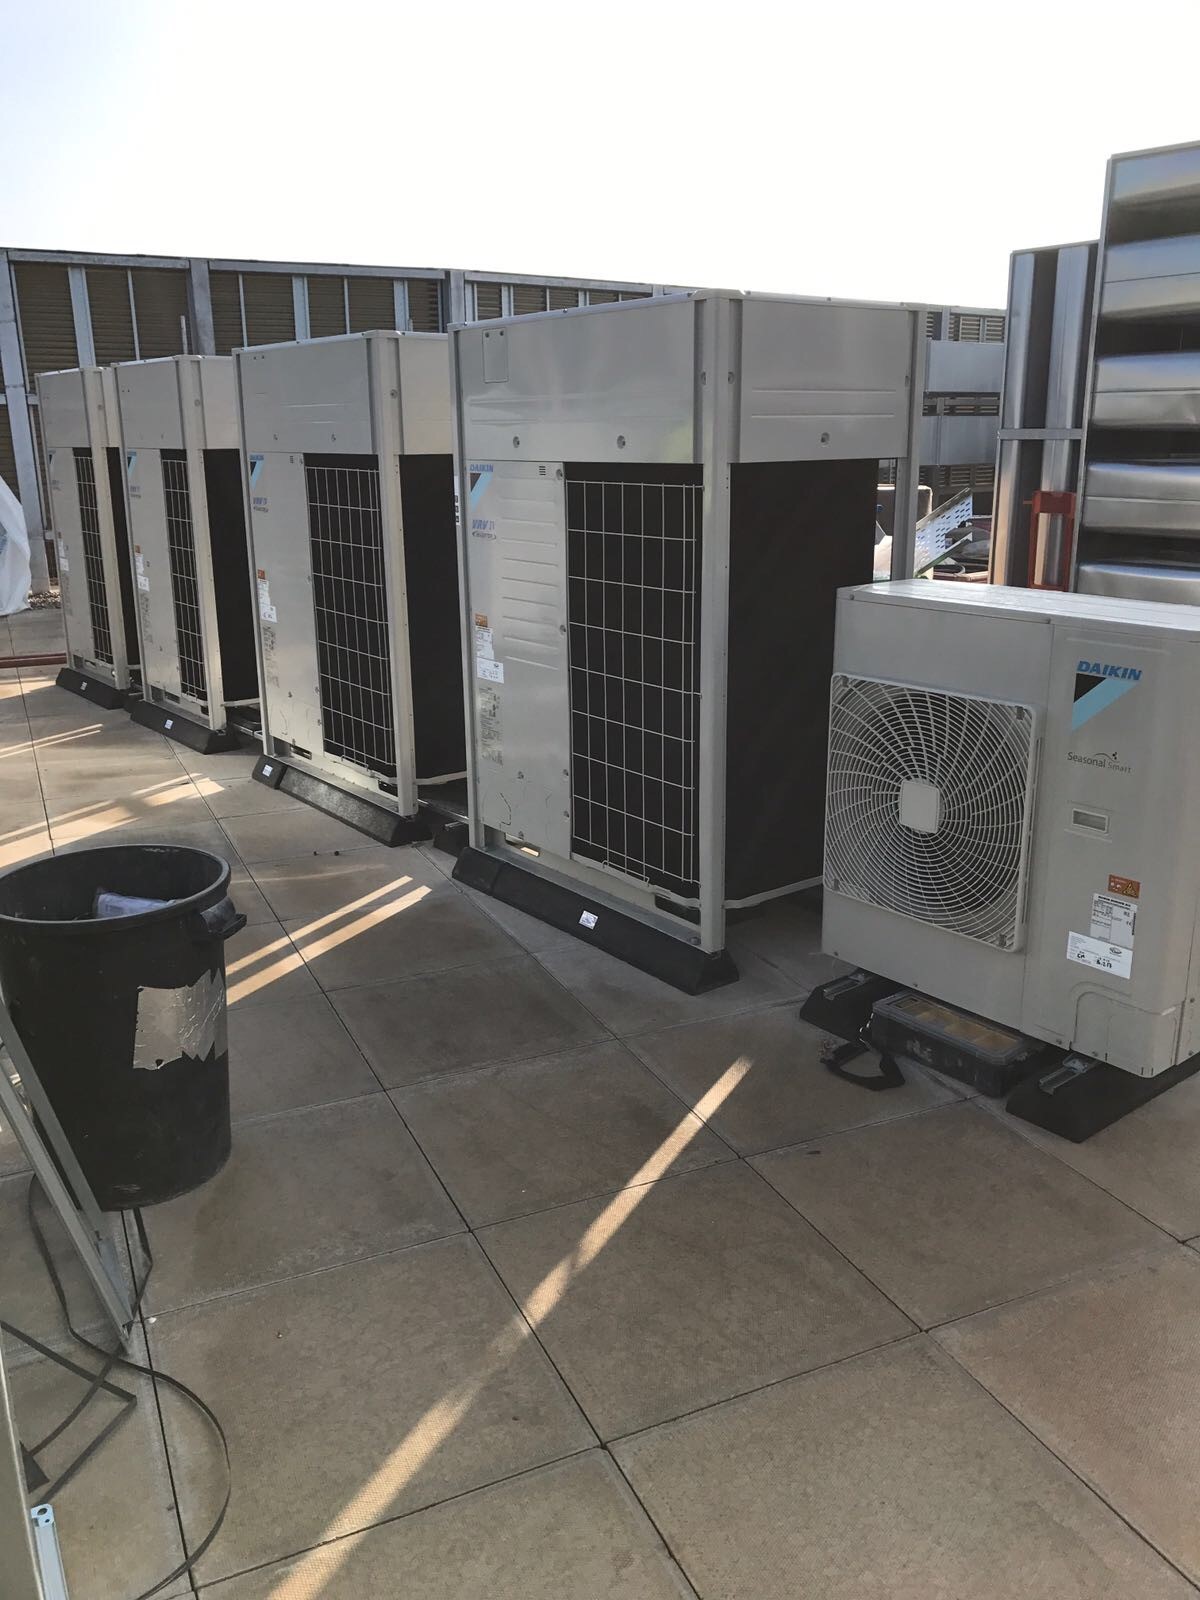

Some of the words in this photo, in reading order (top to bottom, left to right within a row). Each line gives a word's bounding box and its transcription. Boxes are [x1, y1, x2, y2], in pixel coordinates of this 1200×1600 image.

[469, 464, 494, 473] DAIKIN
[1077, 661, 1142, 680] DAIKIN
[1067, 752, 1106, 768] Seasonal
[1107, 761, 1131, 773] Smart
